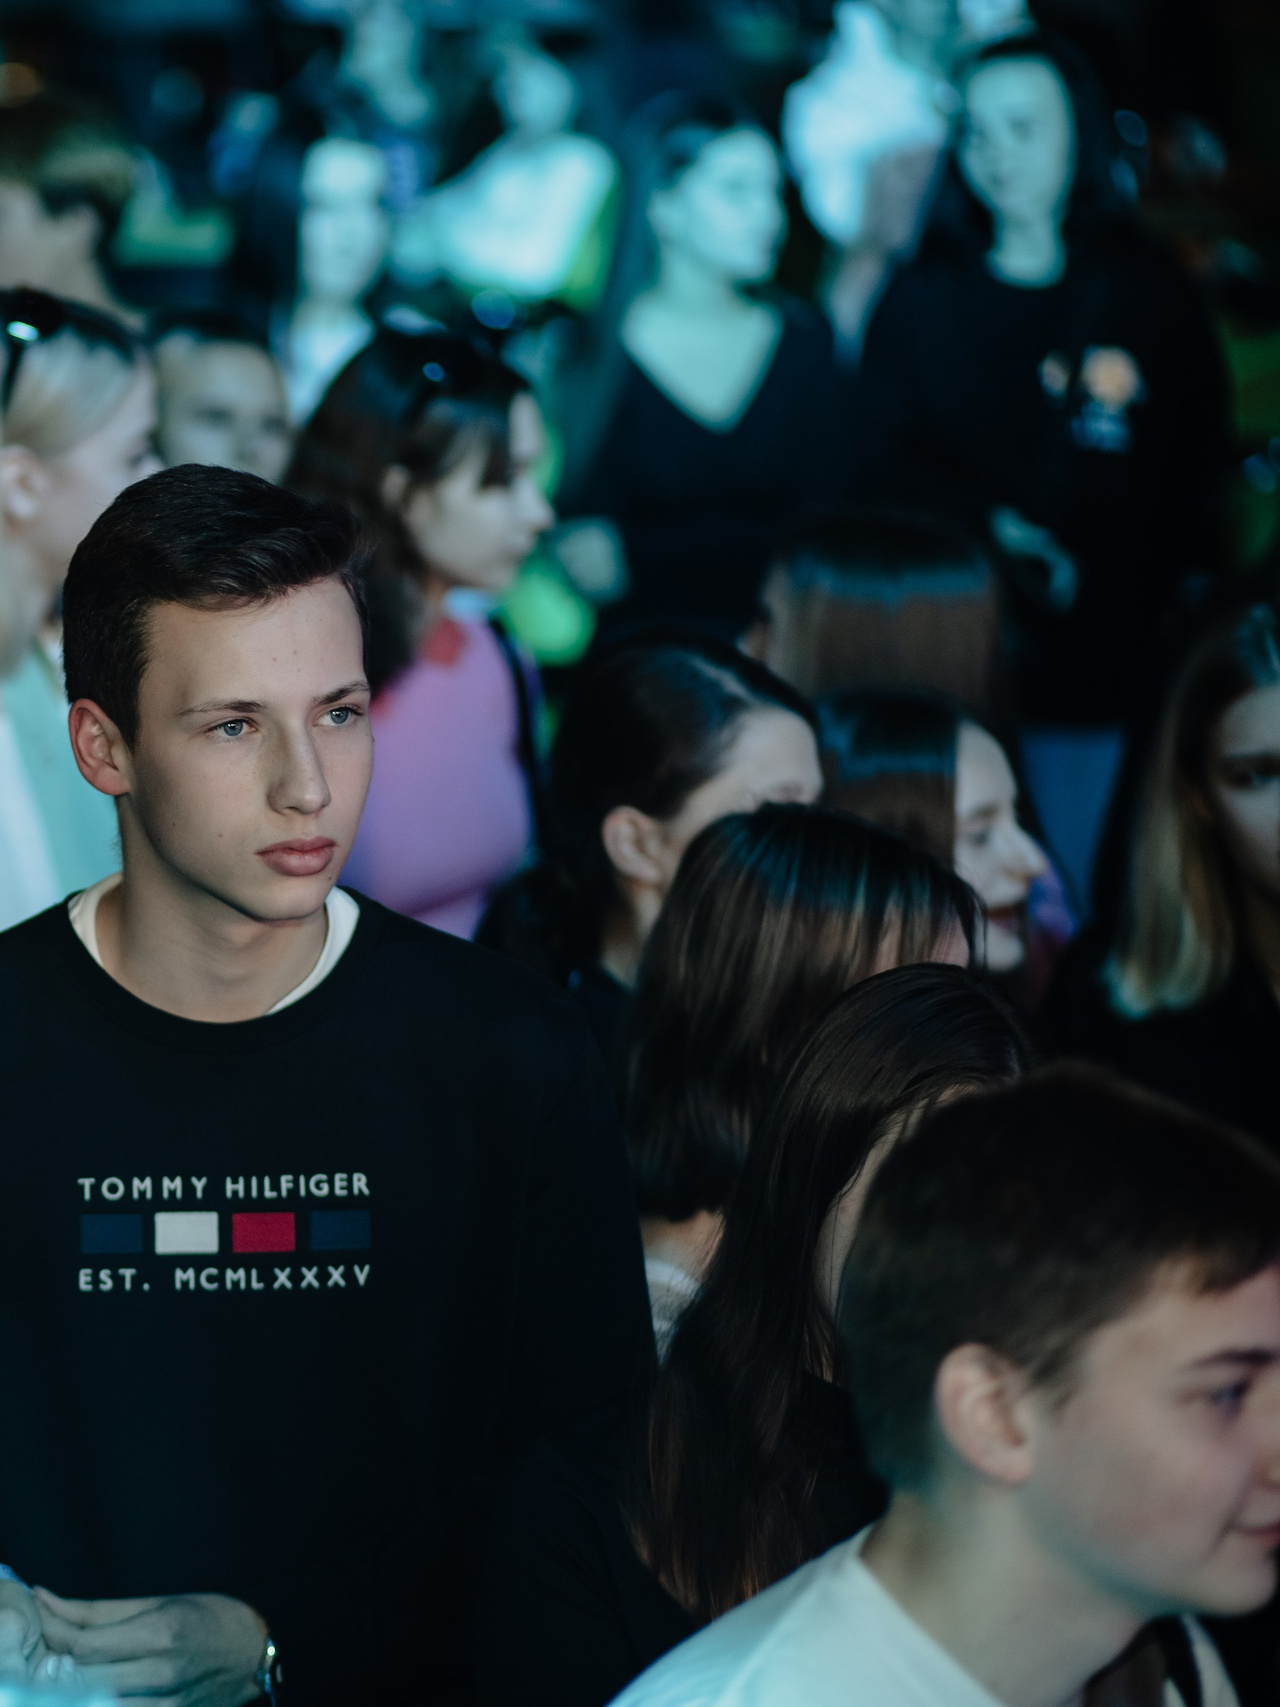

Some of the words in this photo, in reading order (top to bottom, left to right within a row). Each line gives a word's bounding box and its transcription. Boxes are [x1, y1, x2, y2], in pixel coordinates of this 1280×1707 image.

[77, 1174, 208, 1201] TOMMY
[225, 1172, 370, 1199] HILFIGER
[78, 1266, 151, 1292] EST.
[174, 1263, 370, 1291] MCMLXXXV
